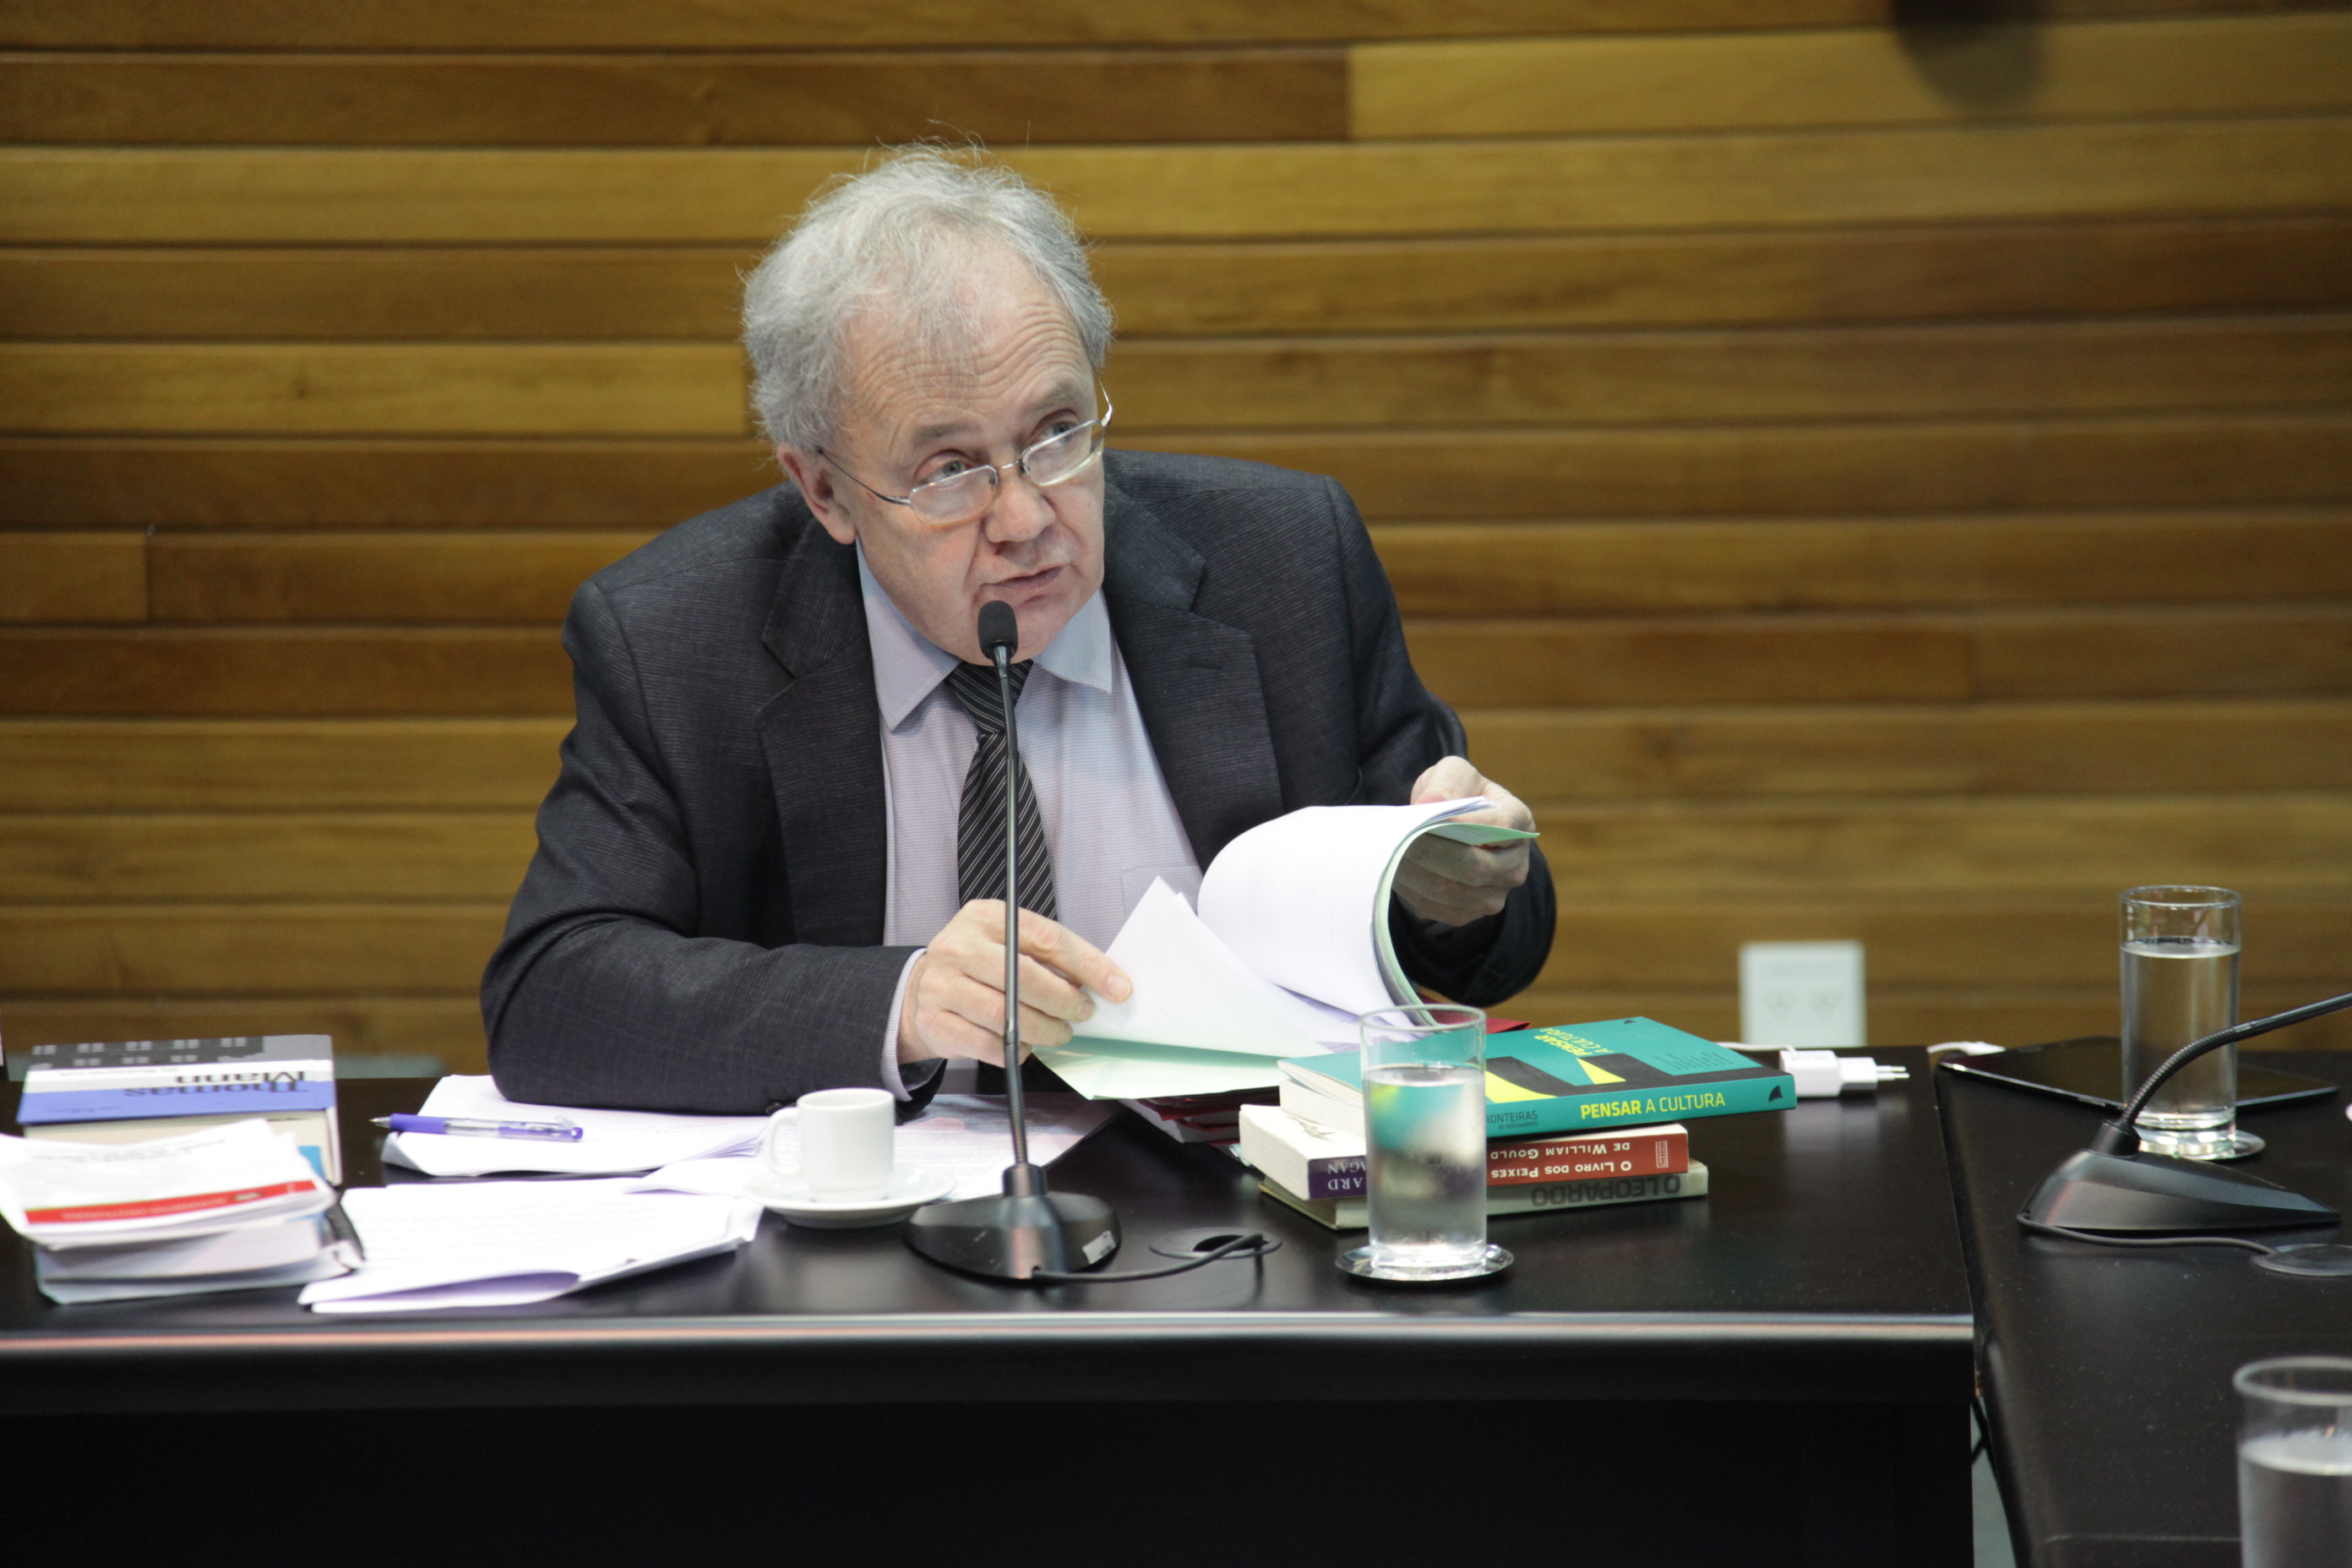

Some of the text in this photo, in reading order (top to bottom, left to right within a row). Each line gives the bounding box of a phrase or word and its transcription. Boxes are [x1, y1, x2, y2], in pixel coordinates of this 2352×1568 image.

[175, 1070, 306, 1084] Mann
[123, 1081, 311, 1097] Thomas
[1580, 1092, 1726, 1119] PENSAR A CULTURA
[1485, 1109, 1538, 1124] RONTEIRAS
[1489, 1142, 1631, 1160] DE WILLIAM GOULD
[1491, 1167, 1539, 1179] PEIXES
[1544, 1165, 1570, 1175] DOS
[1620, 1161, 1632, 1172] O
[1530, 1175, 1681, 1207] O LEOPARDO
